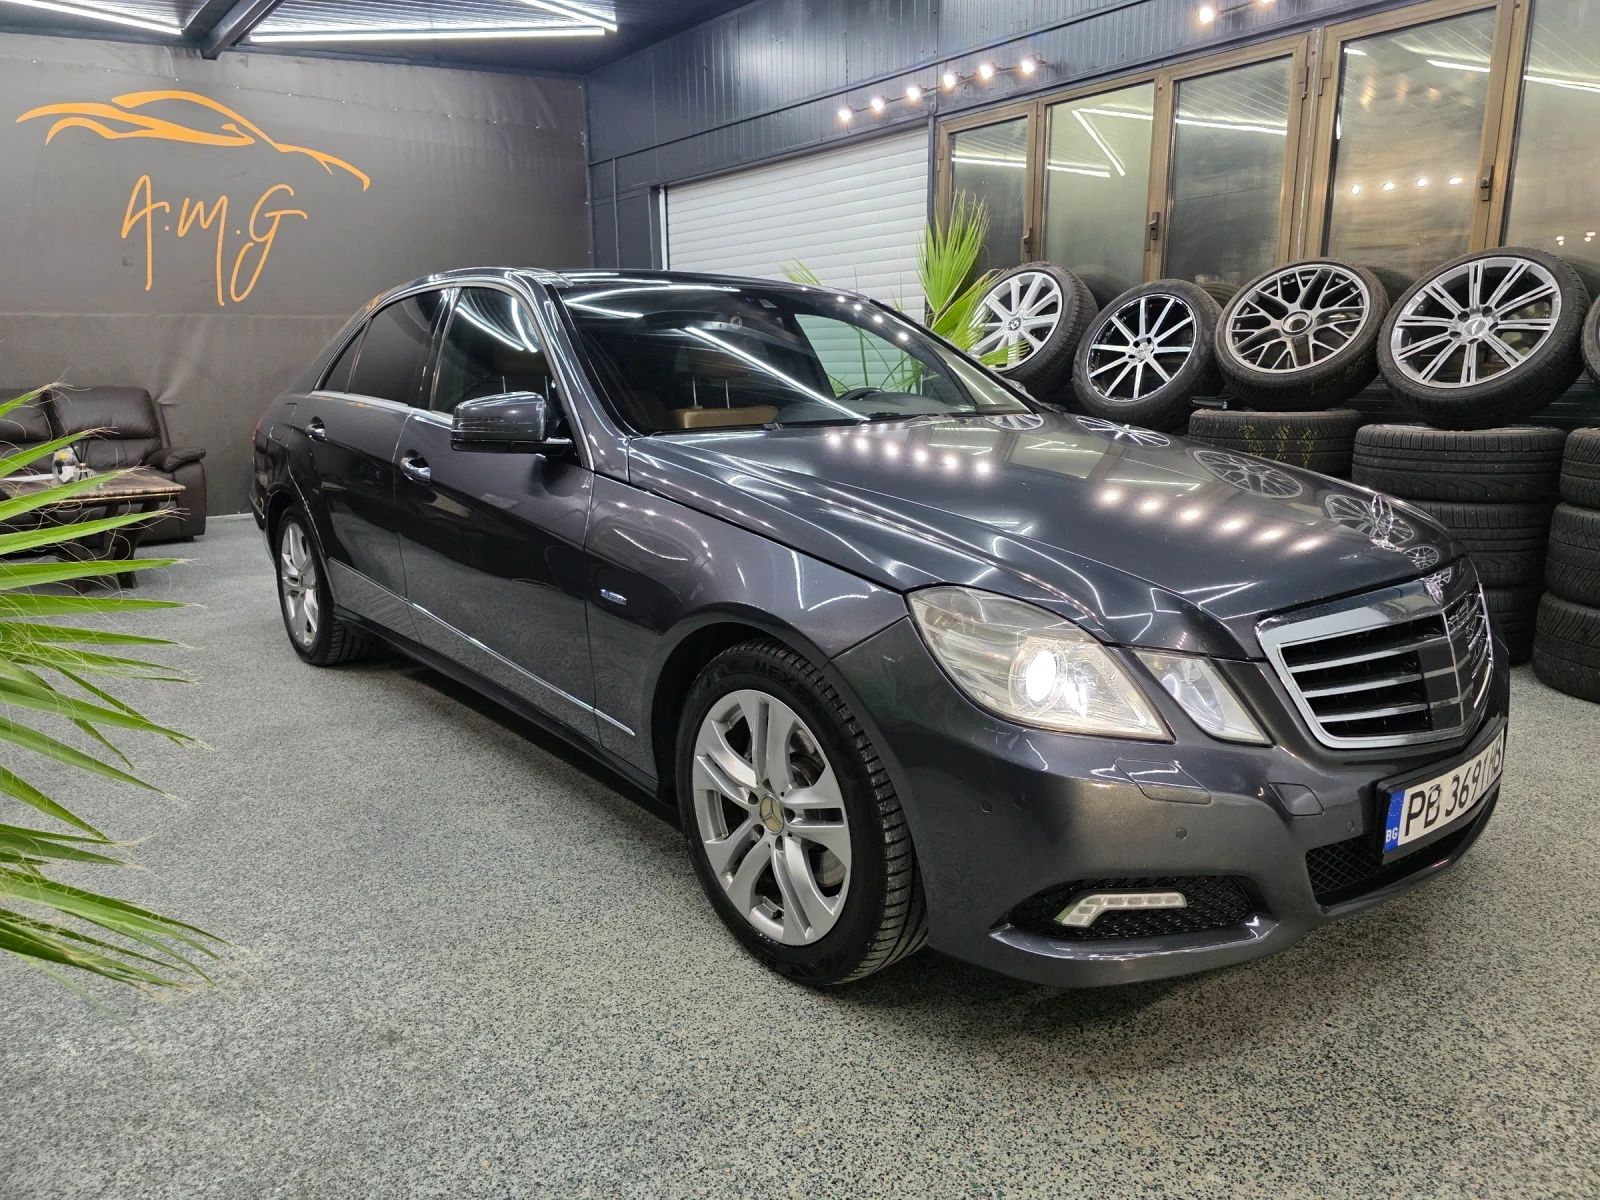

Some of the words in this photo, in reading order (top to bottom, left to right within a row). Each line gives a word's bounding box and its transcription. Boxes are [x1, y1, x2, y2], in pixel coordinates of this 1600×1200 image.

[753, 659, 822, 713] NEXEN
[1404, 781, 1442, 836] PB
[1445, 751, 1488, 817] 3691
[1385, 827, 1399, 843] BG
